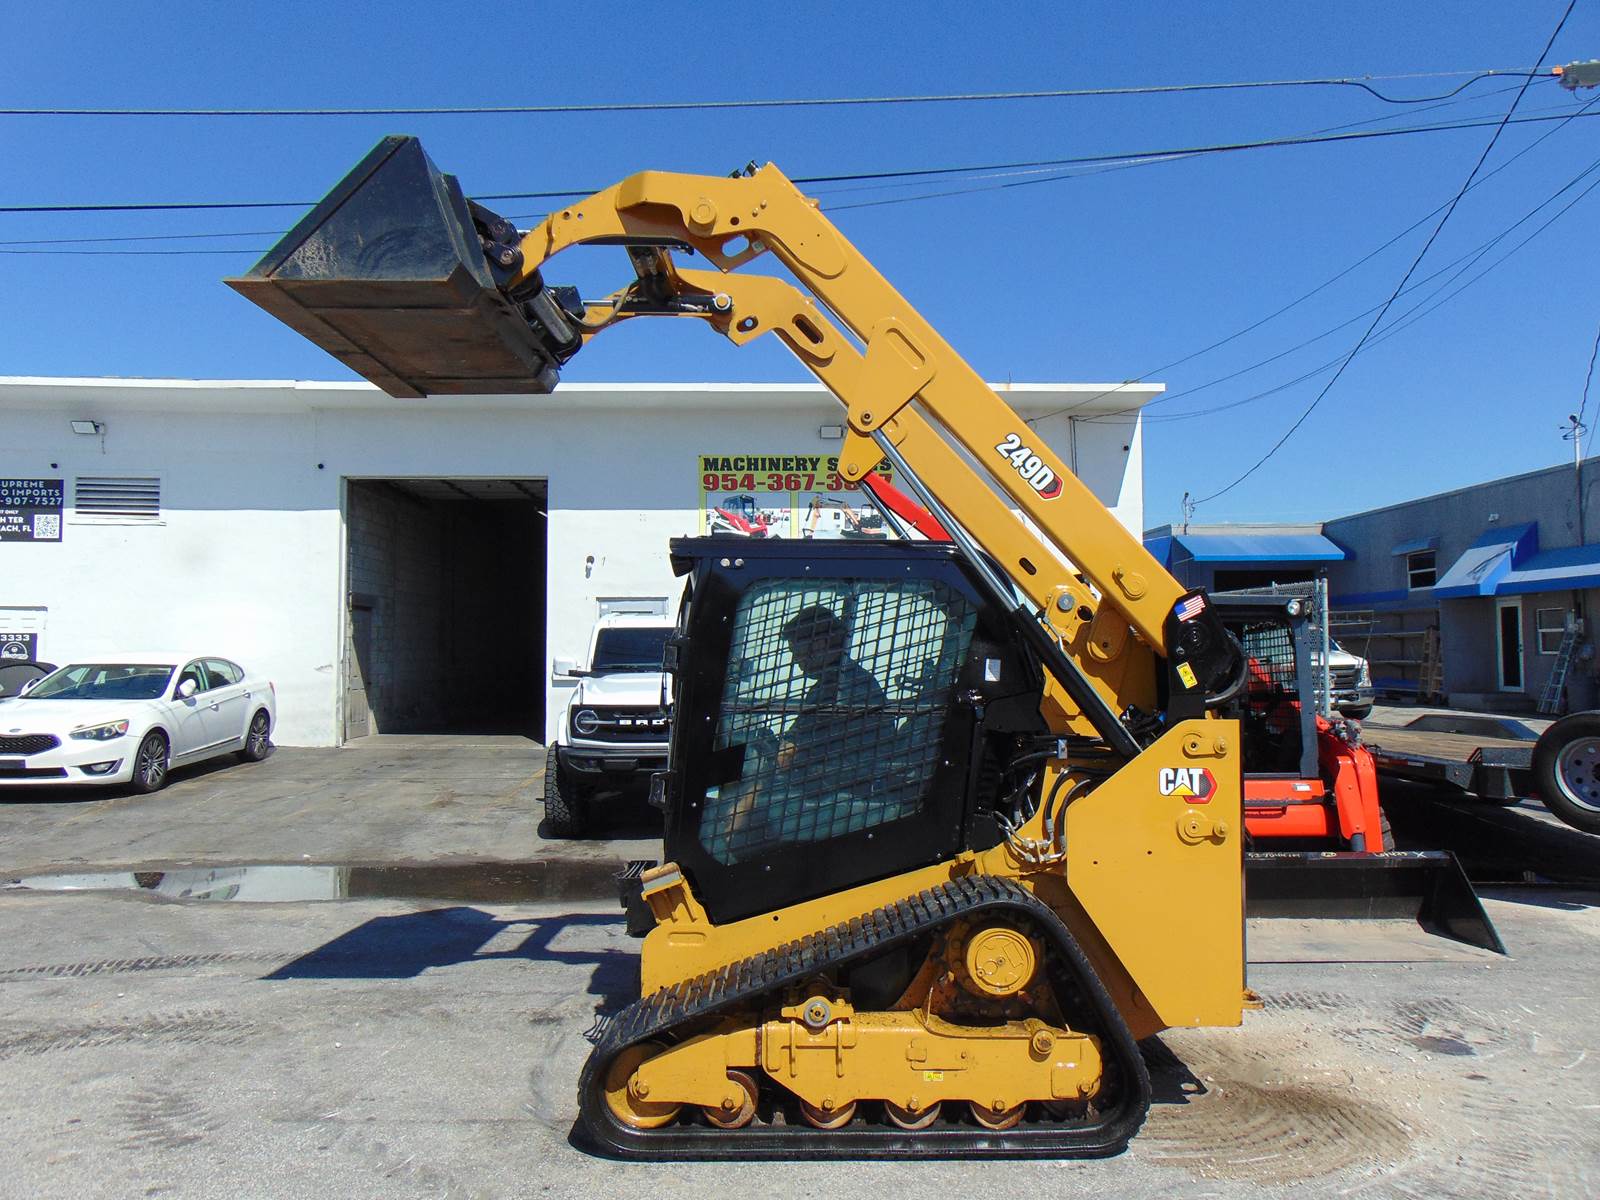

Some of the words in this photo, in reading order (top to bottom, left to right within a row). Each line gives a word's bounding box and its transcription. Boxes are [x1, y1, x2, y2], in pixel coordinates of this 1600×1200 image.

[703, 456, 820, 472] MACHINERY
[994, 432, 1055, 492] 249D
[703, 473, 892, 491] 954-367-37
[1159, 767, 1204, 796] CAT
